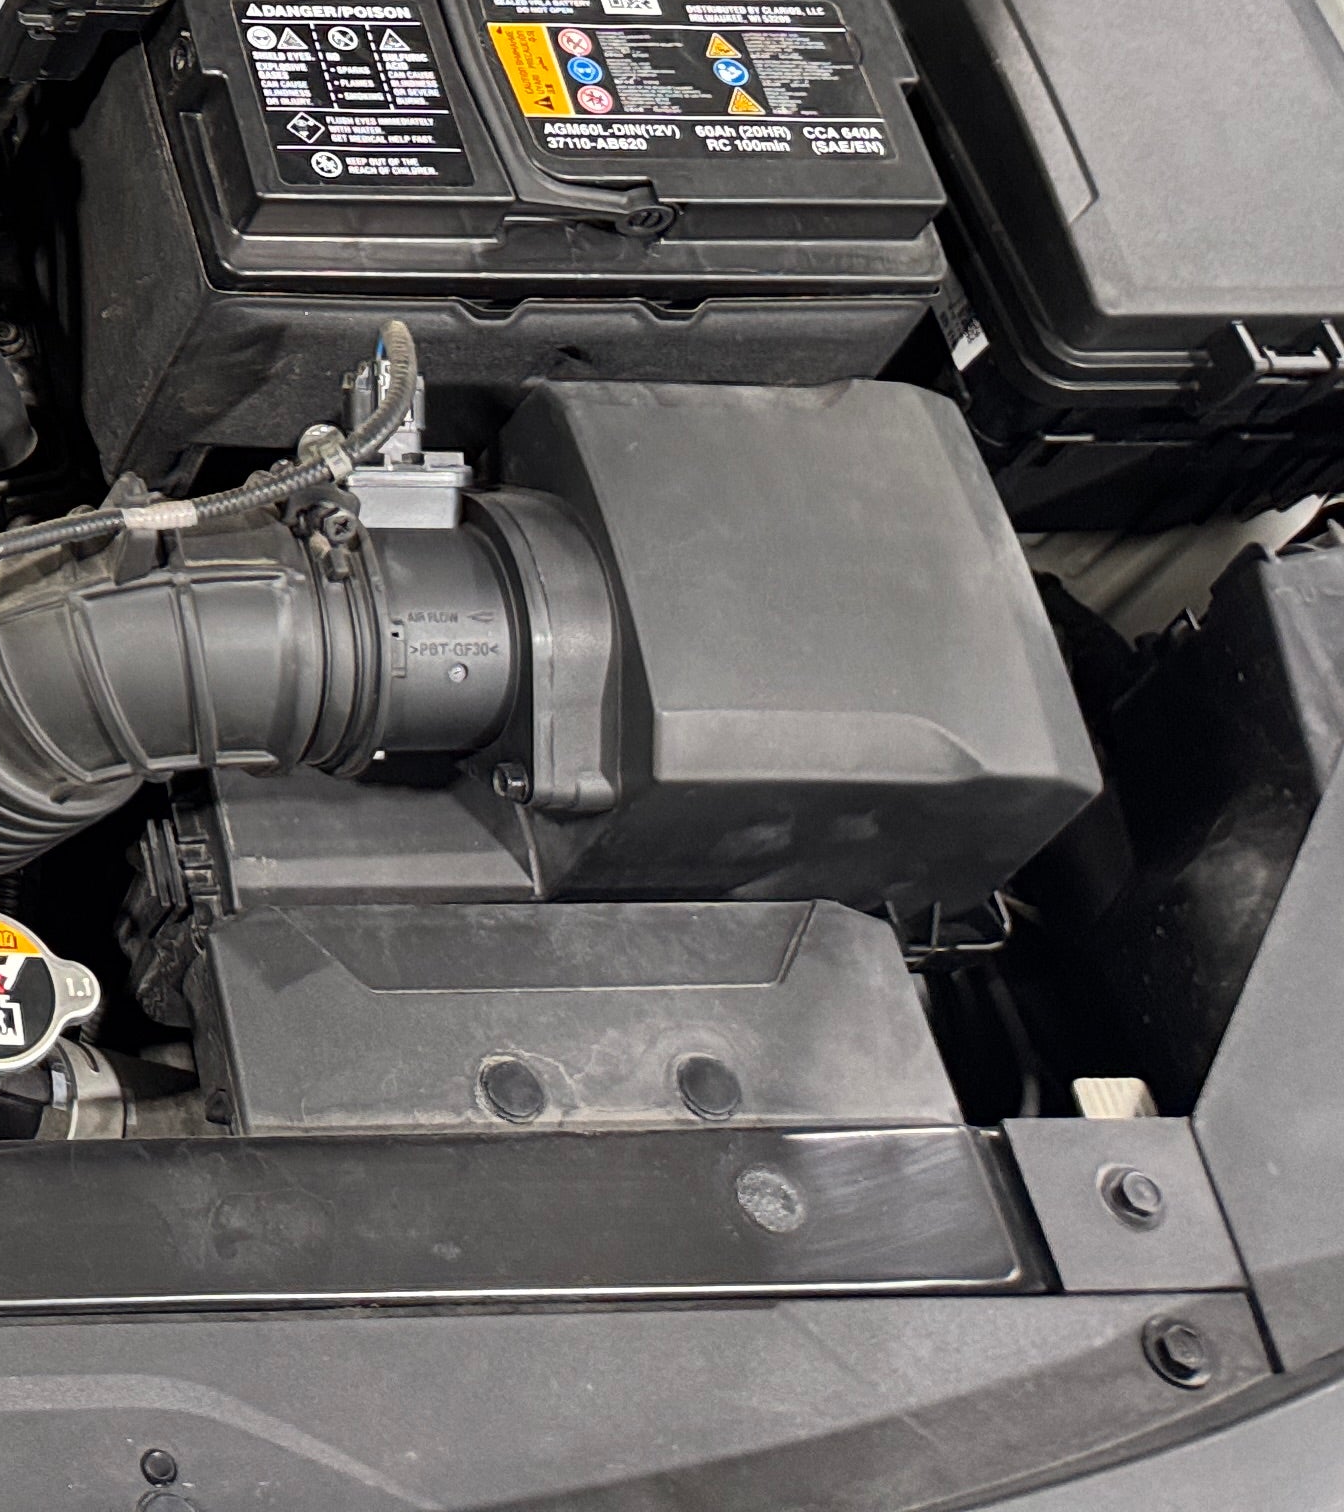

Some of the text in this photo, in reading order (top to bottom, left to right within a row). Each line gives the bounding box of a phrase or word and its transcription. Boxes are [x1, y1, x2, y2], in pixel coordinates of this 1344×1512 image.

[261, 5, 411, 19] DANGER/POISON
[551, 7, 574, 15] OPEN
[686, 5, 747, 15] DISTRIBUTED
[747, 6, 761, 15] BY
[806, 7, 825, 16] LLC
[747, 15, 761, 23] WI
[255, 62, 308, 72] EXPLOSIVE
[385, 62, 409, 71] ACID
[325, 116, 354, 125] FLUSH
[377, 117, 434, 126] IMMEDIATELY
[544, 122, 883, 141] AGM60L-DIN(12V) 60Ah (20HR) CCA 640A
[388, 135, 411, 144] HELP
[546, 137, 885, 156] 37110-AB620 RC 100min (SAE/EN)
[345, 157, 368, 165] KEEP
[368, 157, 387, 166] OUT
[347, 166, 378, 175] REACH
[65, 977, 93, 997] 1.1
